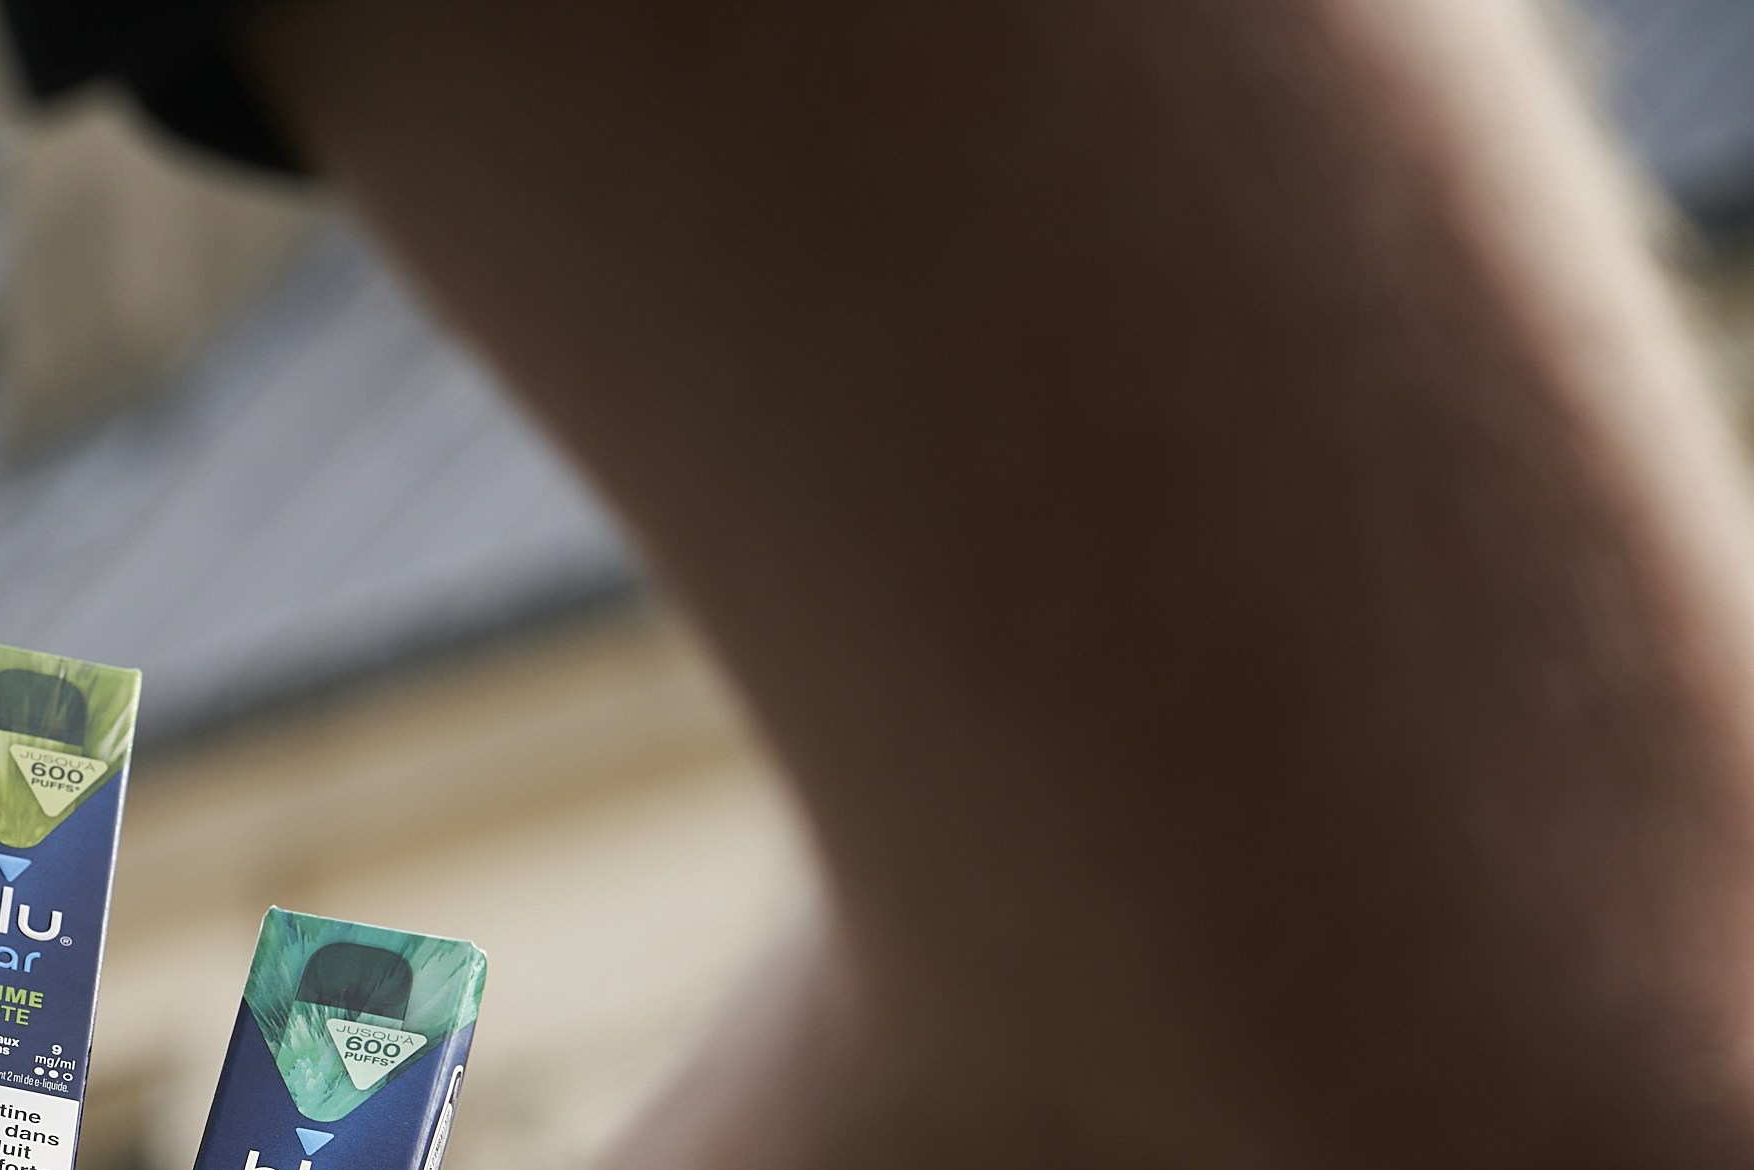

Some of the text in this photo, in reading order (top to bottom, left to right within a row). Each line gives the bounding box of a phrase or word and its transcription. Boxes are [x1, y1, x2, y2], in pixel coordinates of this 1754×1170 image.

[32, 762, 83, 784] 600
[336, 1026, 414, 1046] JUSQU'À
[52, 1044, 62, 1055] 9
[346, 1036, 400, 1058] 600
[34, 1054, 76, 1070] mg/ml
[6, 1071, 13, 1081] 2
[13, 1074, 24, 1084] ml
[24, 1075, 34, 1086] de
[34, 1078, 68, 1092] e-liquide.
[4, 1124, 60, 1146] dans
